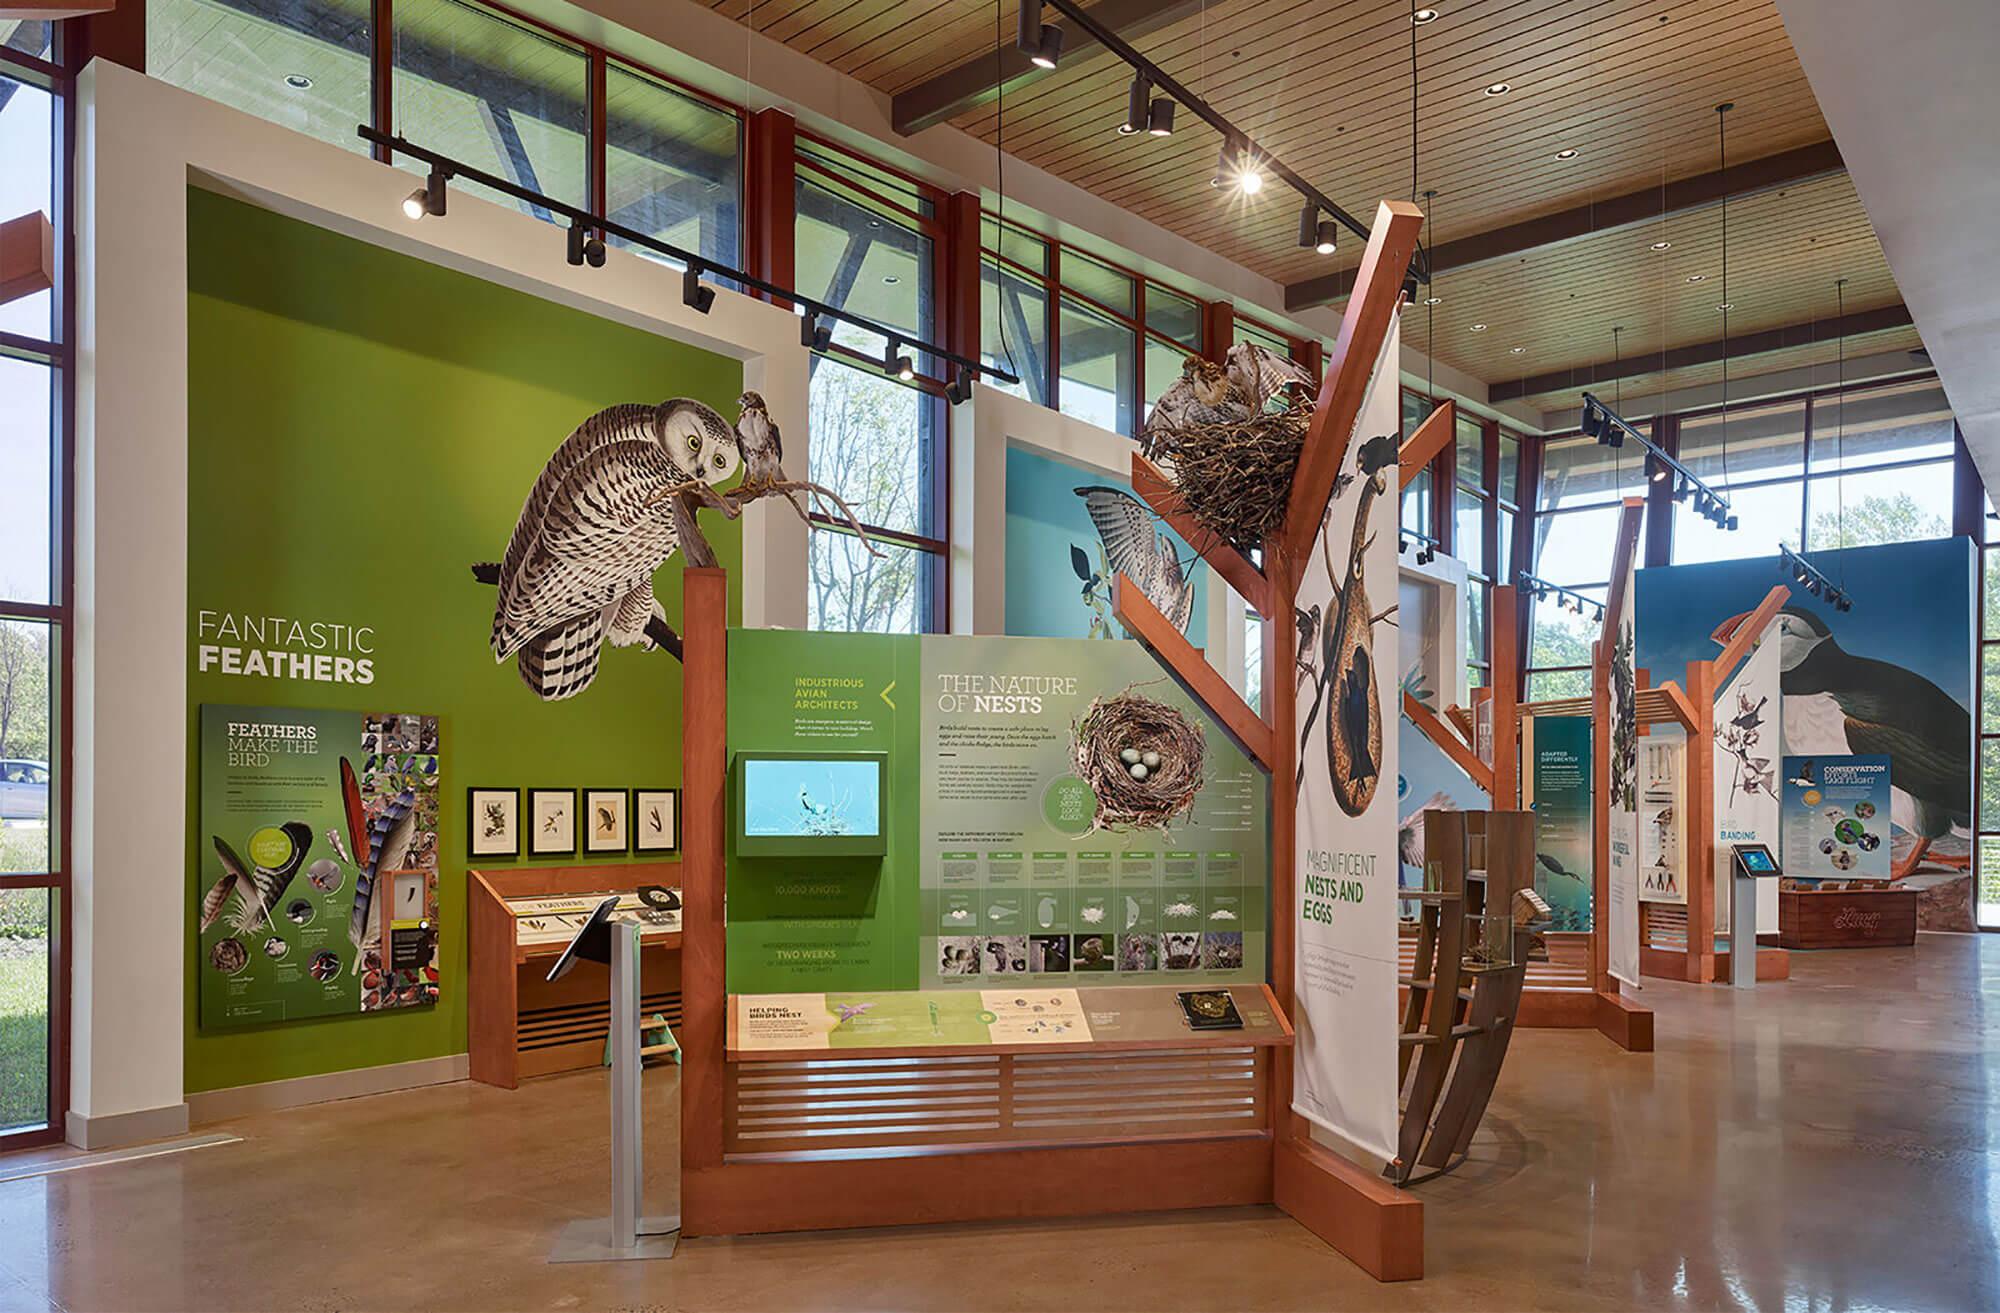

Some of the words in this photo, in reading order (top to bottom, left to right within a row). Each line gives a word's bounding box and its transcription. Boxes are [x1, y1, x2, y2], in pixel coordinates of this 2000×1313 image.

[199, 610, 374, 654] FANTASTIC
[199, 645, 374, 685] FEATHERS
[795, 678, 864, 688] INDUSTRIOUS
[938, 674, 983, 693] THE
[989, 675, 1078, 696] NATURE
[795, 689, 827, 698] AVIAN
[795, 700, 859, 710] ARCHITECTS
[938, 694, 969, 713] OF
[973, 695, 1042, 714] NESTS
[227, 722, 317, 739] FEATHERS
[228, 739, 280, 752] MAKE
[283, 740, 319, 754] THE
[228, 752, 270, 767] BIRD
[1824, 765, 1886, 773] CONSERVATION
[1720, 831, 1756, 840] BANDING
[1306, 849, 1377, 877] MAGNIFICENT
[776, 885, 807, 896] 10,000
[808, 885, 841, 896] KNOTS
[1305, 874, 1337, 899] NESTS
[1339, 880, 1363, 903] AND
[537, 901, 585, 909] FEATHERS
[1303, 899, 1333, 925] EGGS
[776, 950, 800, 959] TWO
[802, 950, 837, 959] WEEKS
